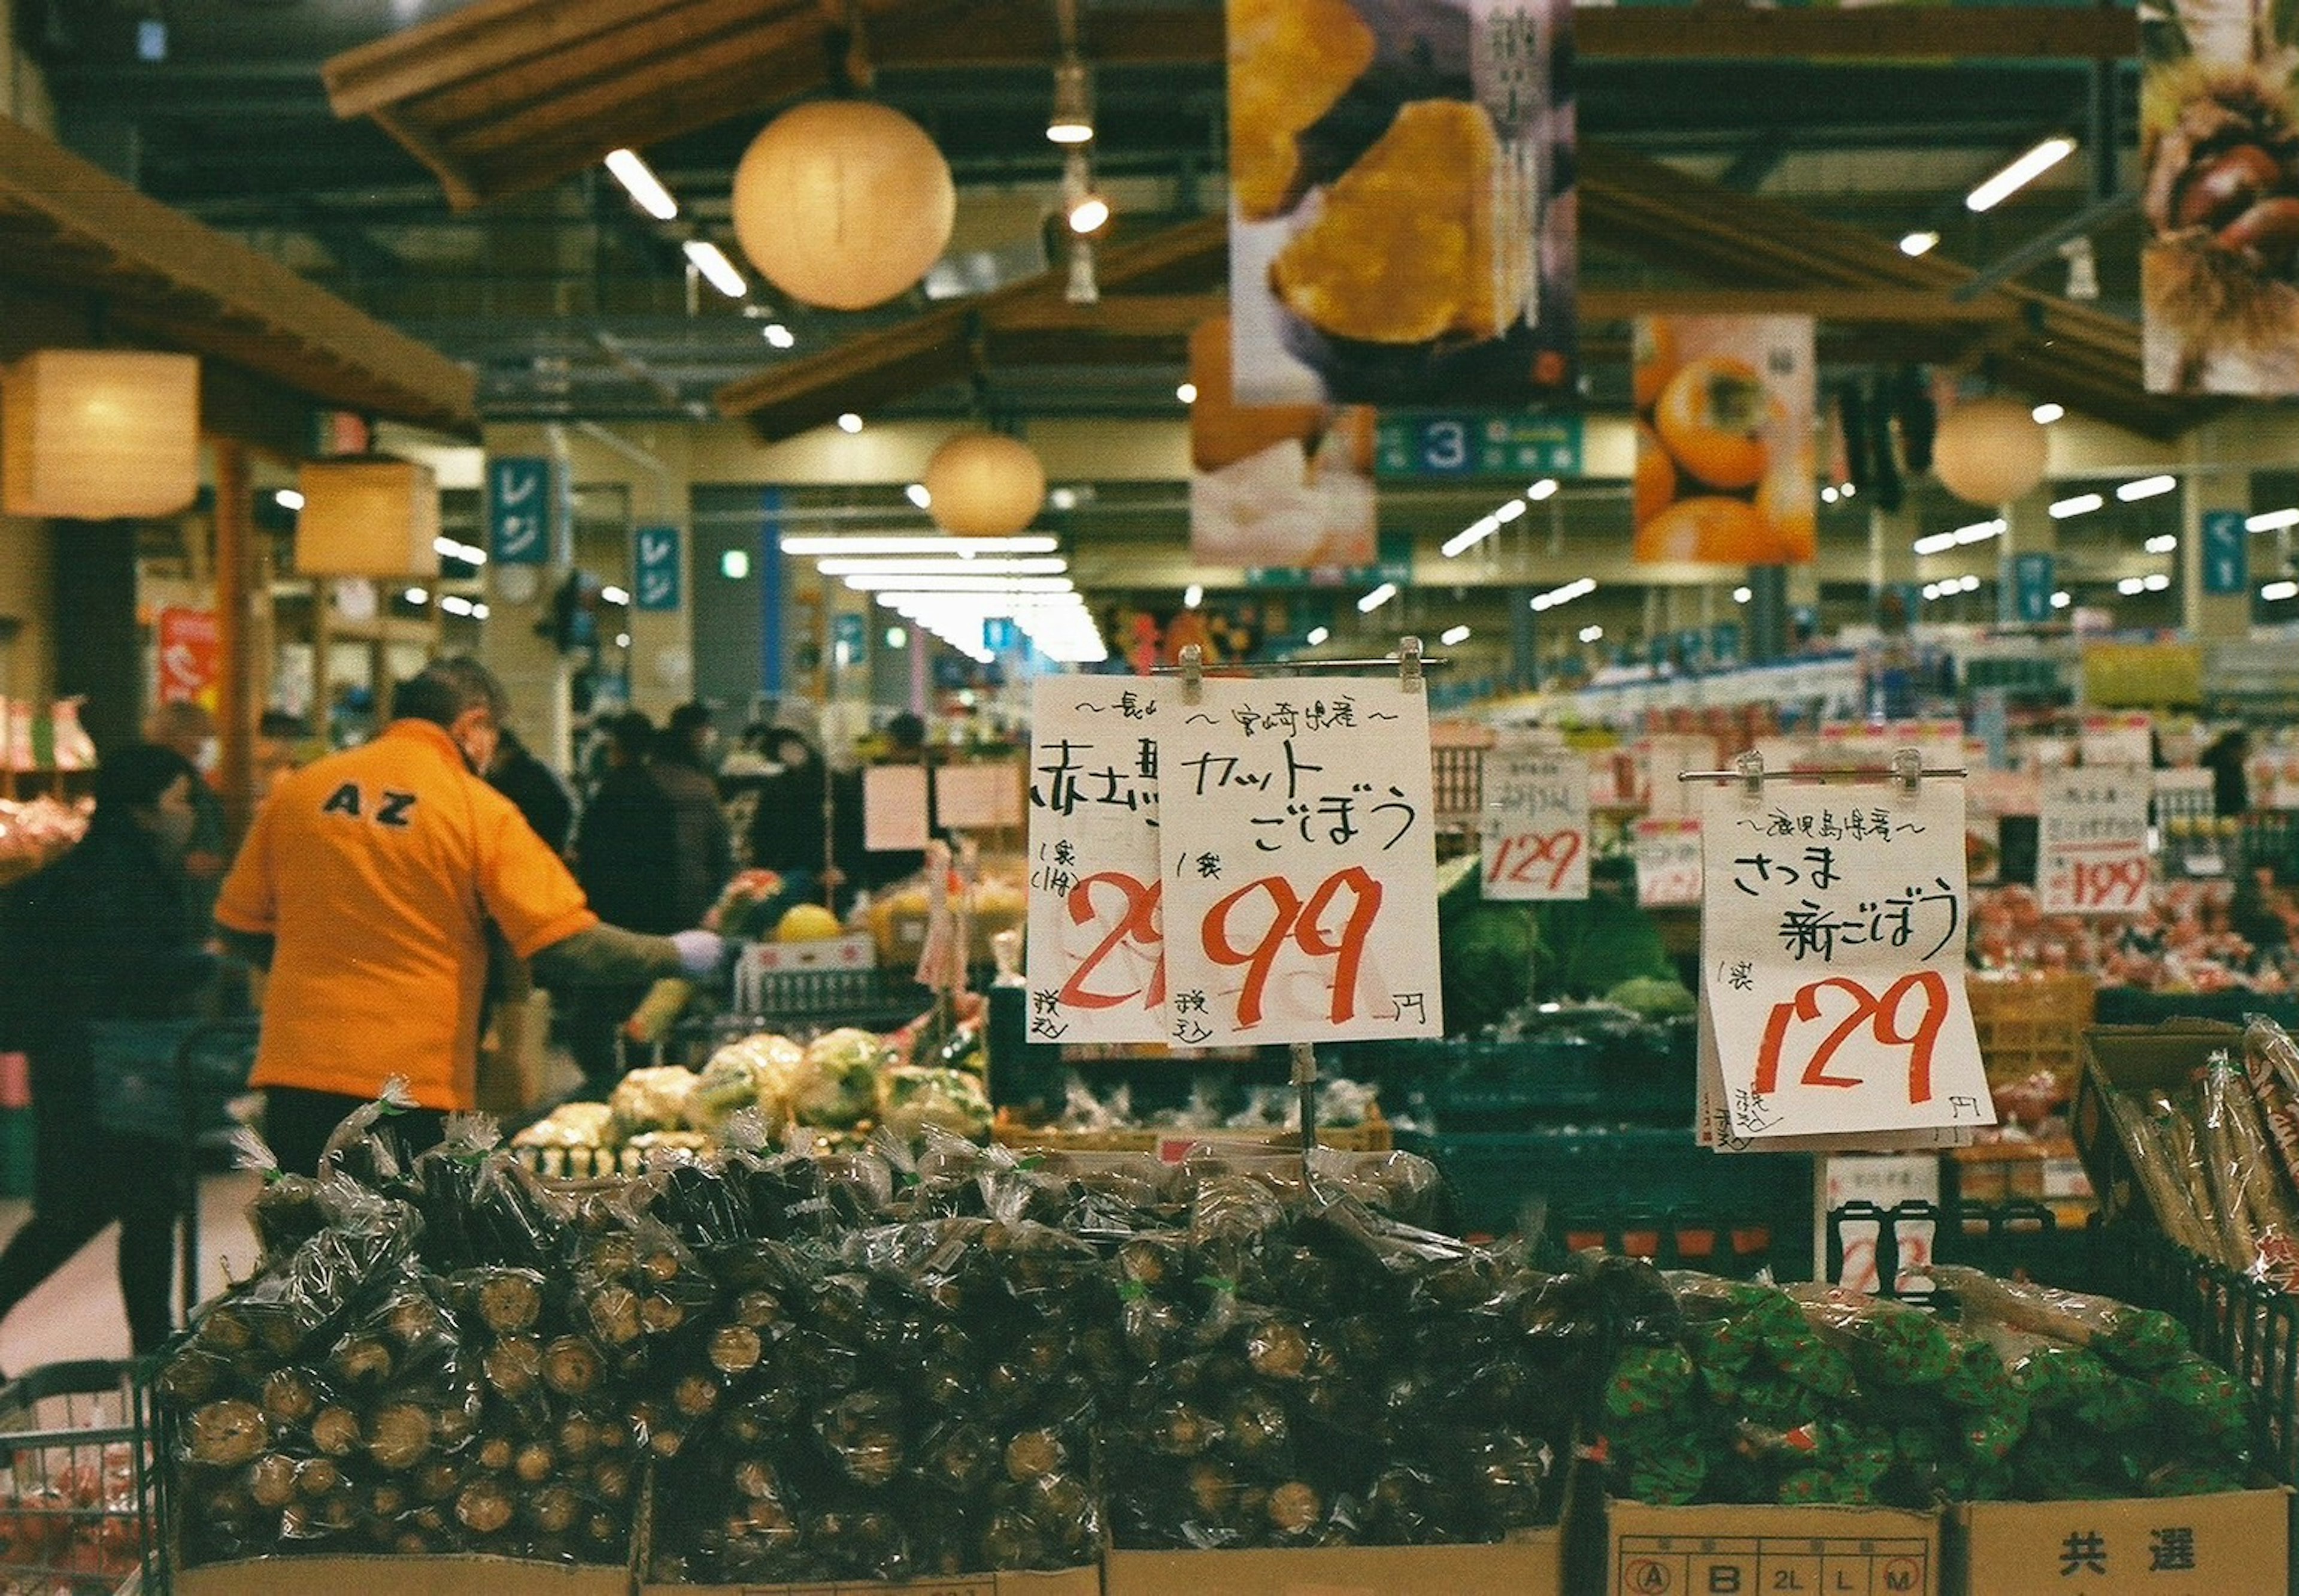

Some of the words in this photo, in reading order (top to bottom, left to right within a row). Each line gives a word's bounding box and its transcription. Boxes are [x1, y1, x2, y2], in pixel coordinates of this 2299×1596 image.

[1425, 421, 1464, 468] 3
[1181, 740, 1323, 799] カット
[323, 784, 417, 826] AZ
[1251, 784, 1415, 851] ごぼう
[1488, 830, 1581, 890] 129
[1734, 846, 1841, 895] さつま
[1779, 877, 1958, 961] 新ごぼう
[1202, 866, 1382, 1027] 99
[1393, 993, 1426, 1025] 円
[1752, 970, 1949, 1105] 129
[1949, 1096, 1980, 1119] 円
[1709, 1567, 1739, 1592] B
[1775, 1570, 1803, 1590] 2L
[1837, 1571, 1852, 1589] L
